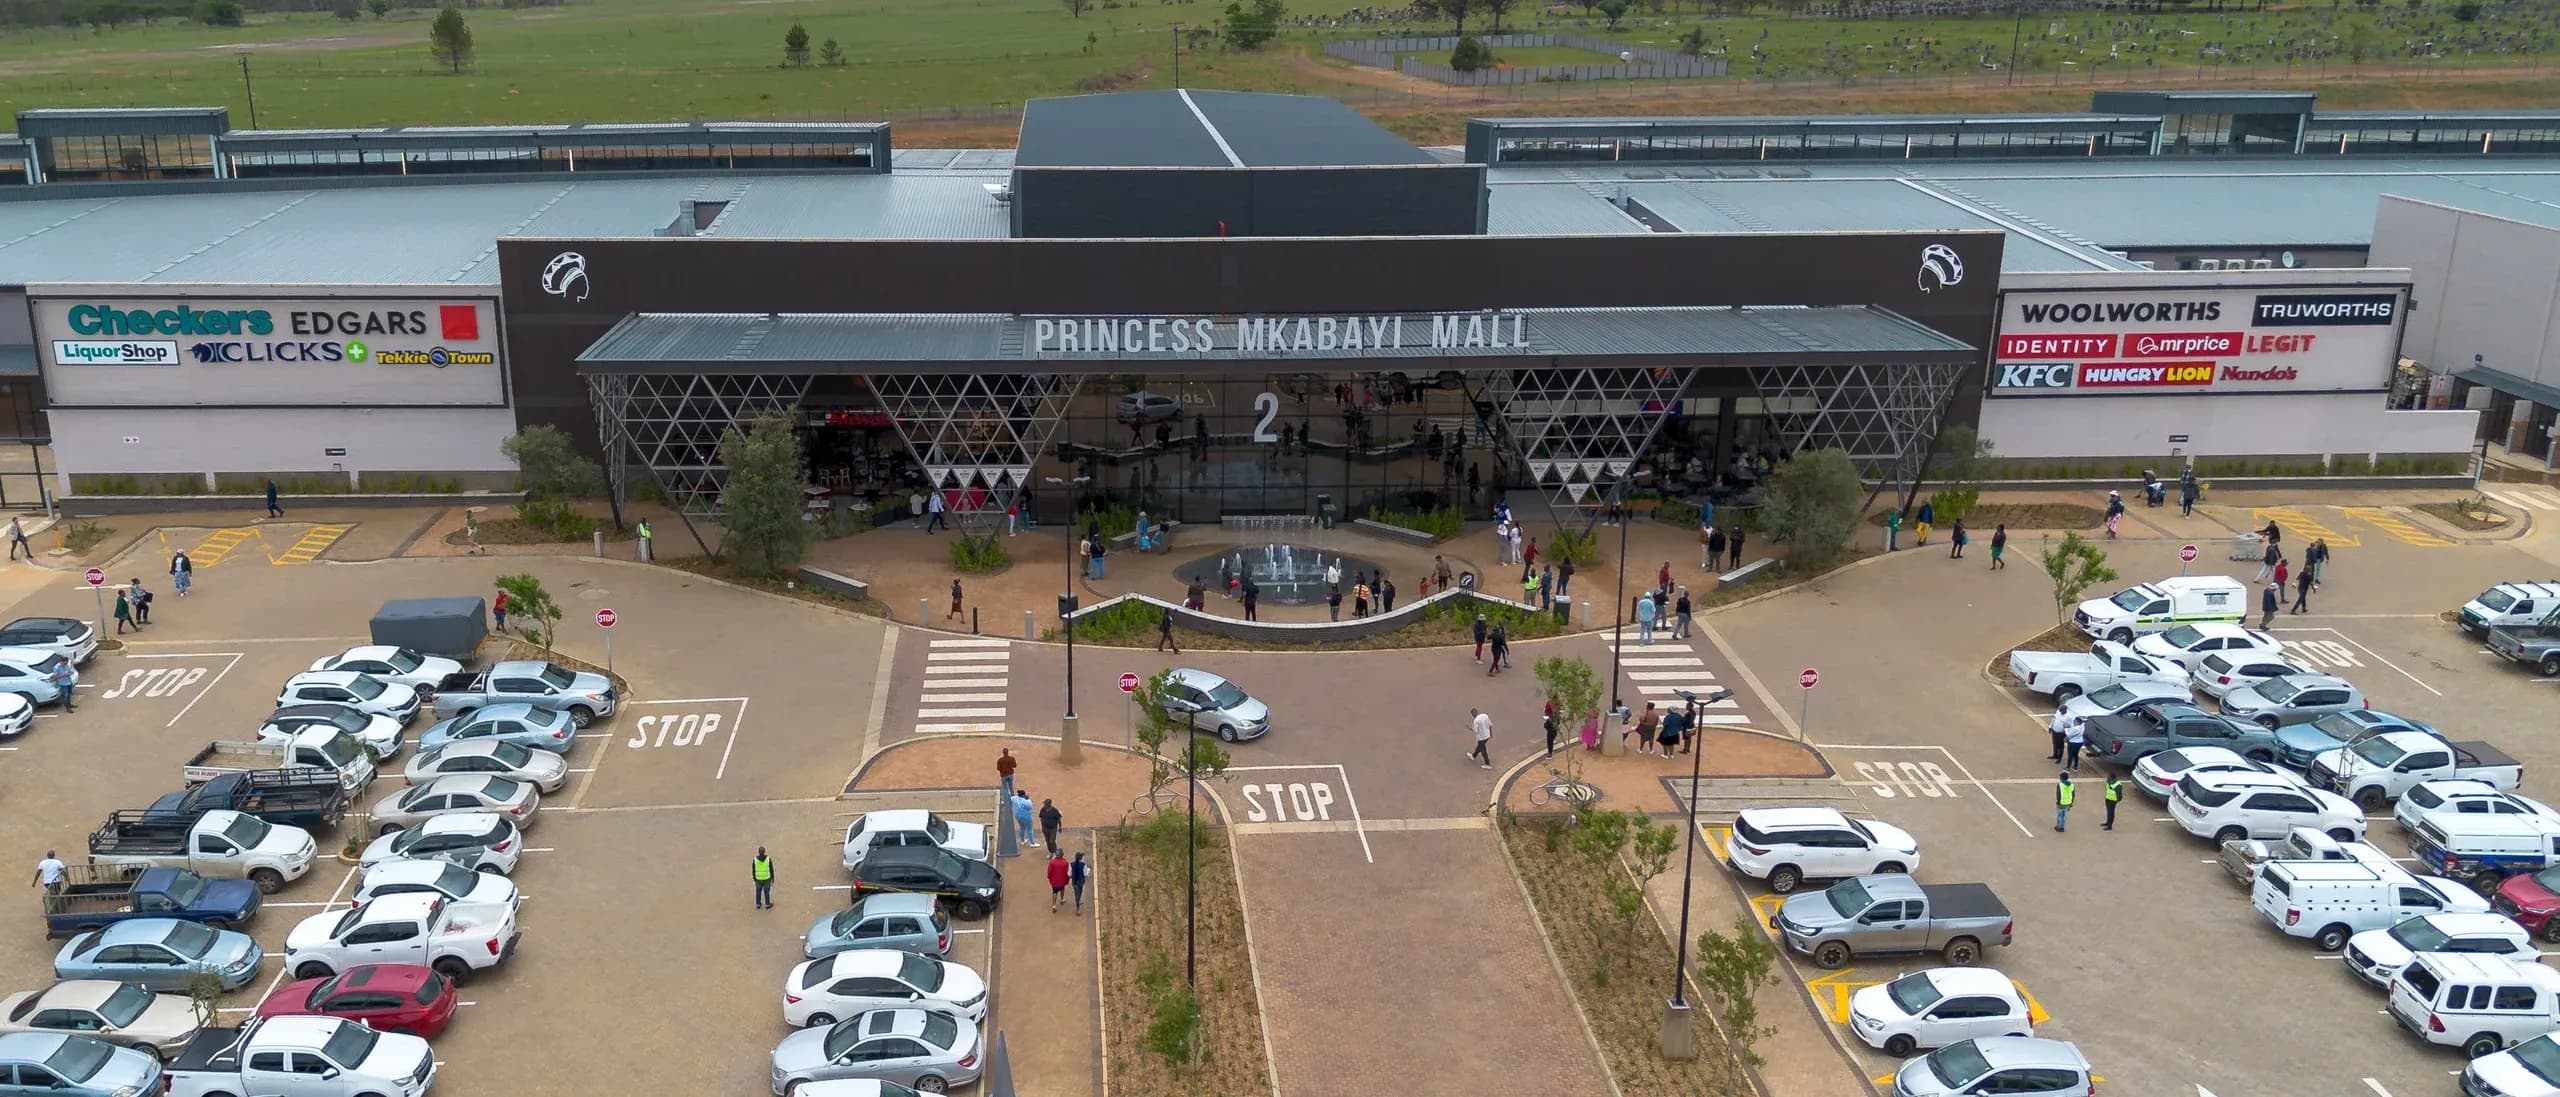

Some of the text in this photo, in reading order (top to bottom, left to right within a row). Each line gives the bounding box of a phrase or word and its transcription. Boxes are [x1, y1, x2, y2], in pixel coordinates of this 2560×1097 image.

[68, 304, 274, 336] Checkers
[2022, 301, 2221, 323] WOOLWORTHS
[2260, 303, 2392, 318] TRUWORTHS
[291, 311, 427, 335] EDGARS
[1035, 314, 1530, 352] PRINCESS MKABAYI MALL
[221, 341, 343, 362] CLICKS
[2007, 339, 2109, 354] IDENTITY
[376, 350, 493, 365] Tekkie Town
[1998, 364, 2069, 388] KFC
[2085, 366, 2211, 383] HUNGRY LION
[2220, 365, 2298, 382] Nando's
[1254, 392, 1279, 443] 2
[2181, 549, 2196, 558] STOP
[87, 572, 103, 581] STOP
[598, 614, 615, 623] STOP
[102, 667, 208, 699] STOP
[1120, 678, 1138, 687] STOP
[1801, 674, 1817, 683] STOP
[628, 713, 722, 748] STOP
[1853, 761, 1958, 798] STOP
[1242, 782, 1334, 822] STOP
